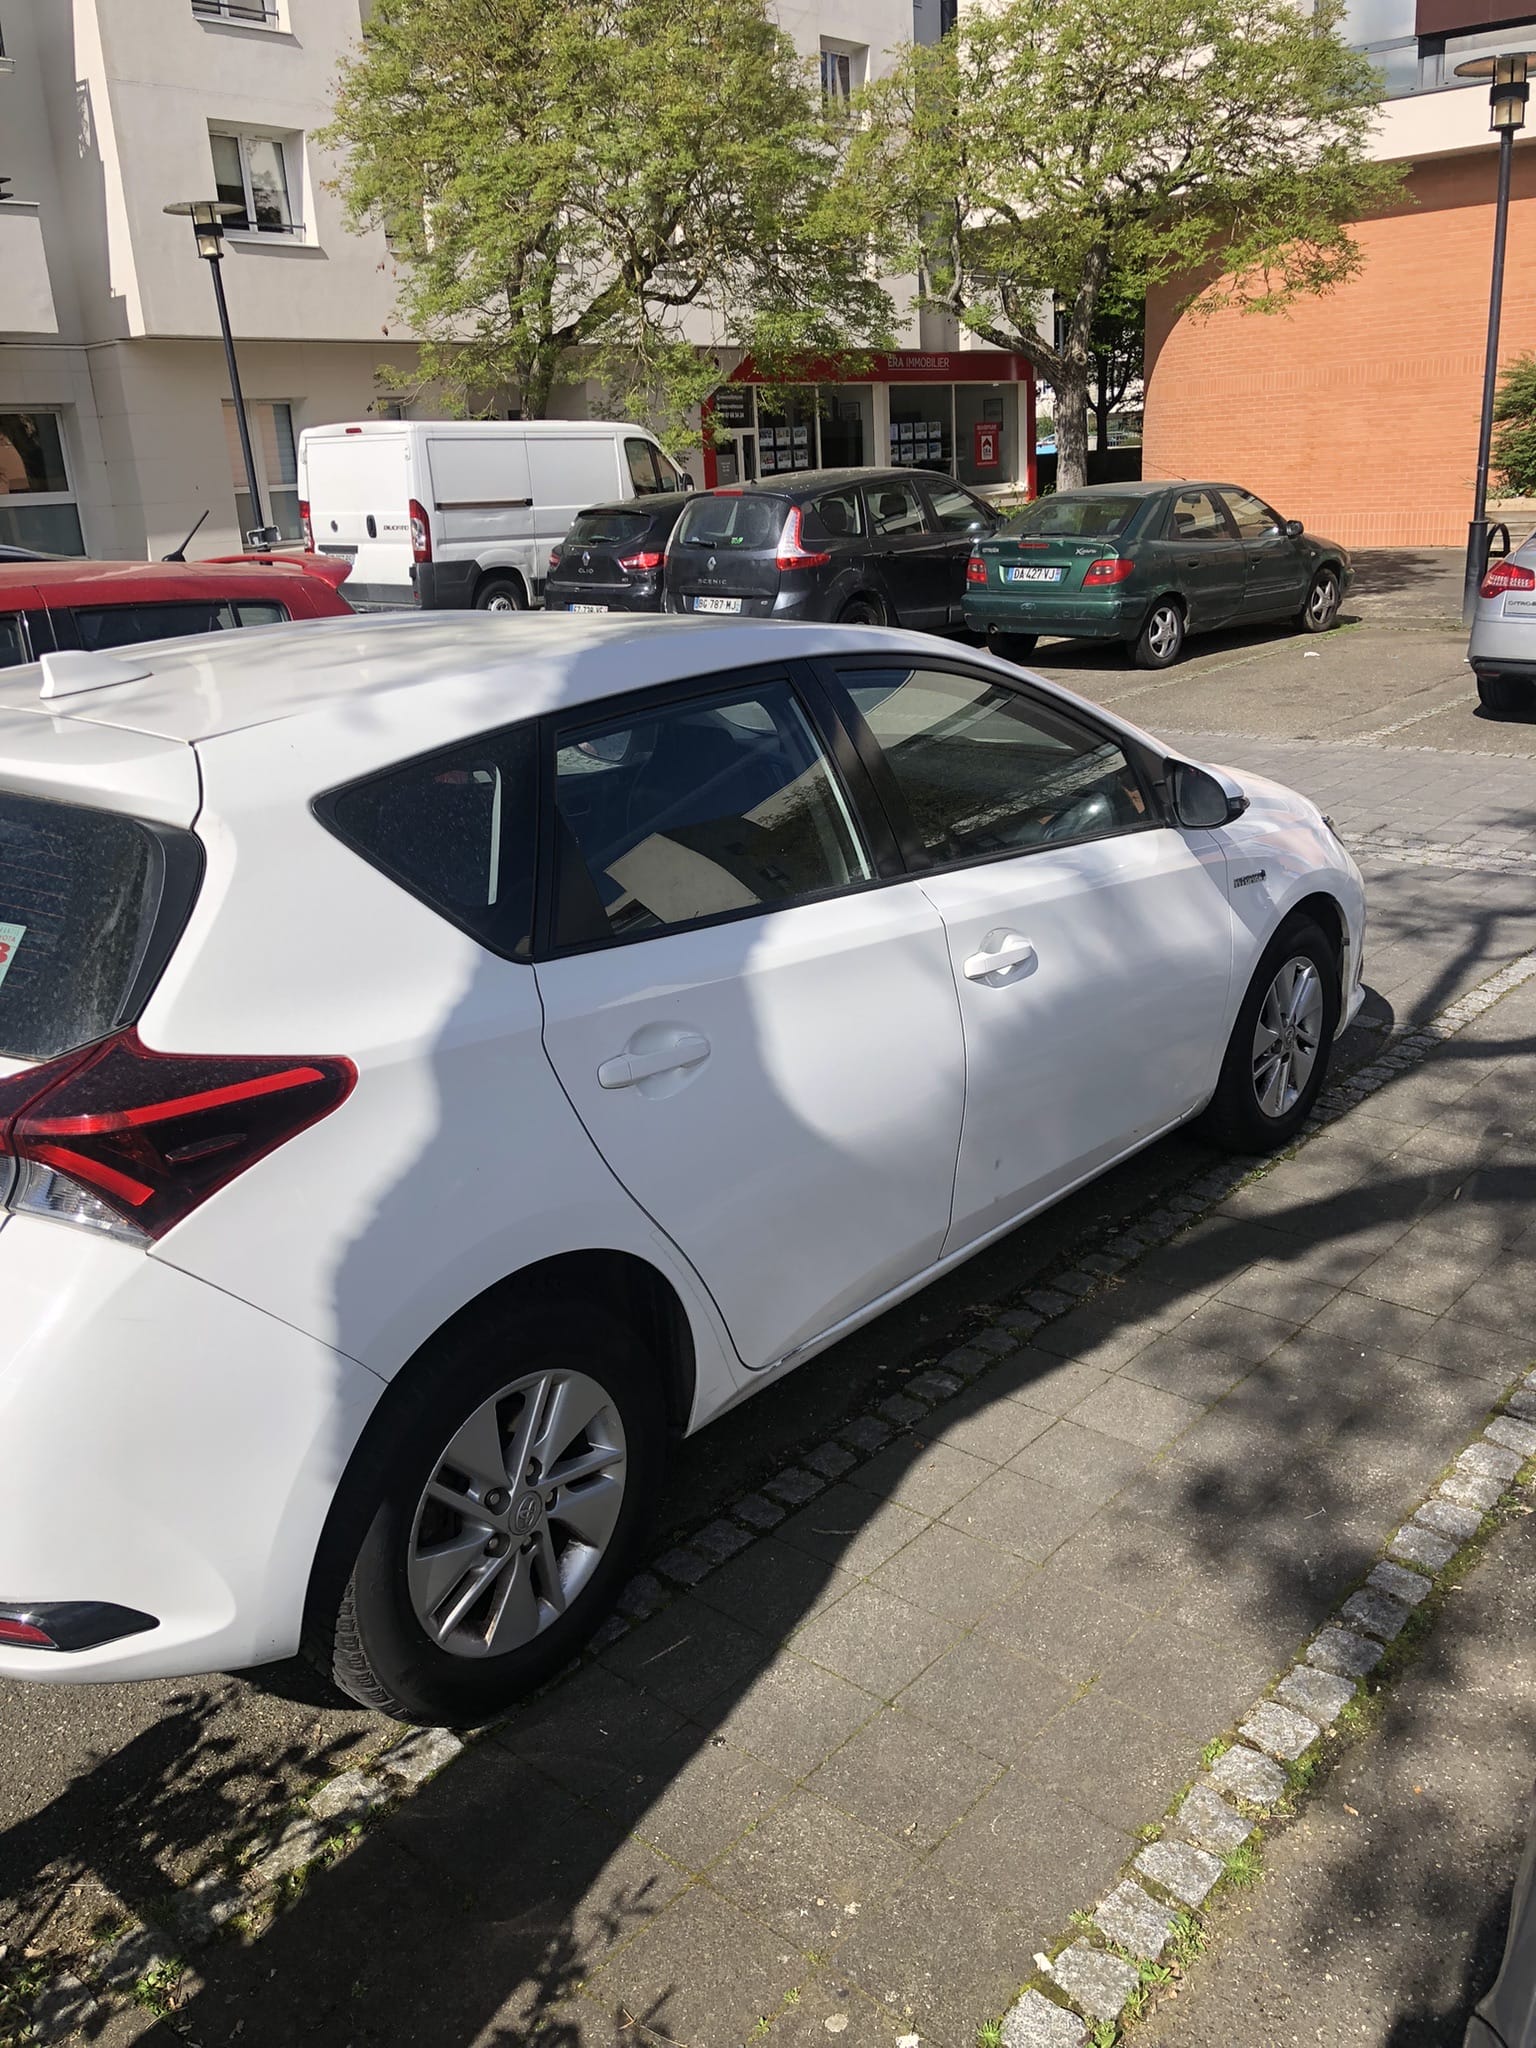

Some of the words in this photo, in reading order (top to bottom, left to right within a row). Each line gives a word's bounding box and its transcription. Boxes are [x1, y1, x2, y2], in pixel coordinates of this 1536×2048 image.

[905, 357, 950, 368] IMMOBILIER
[1013, 568, 1025, 580] DA
[1026, 567, 1042, 580] 427
[1044, 568, 1056, 580] VJ
[709, 599, 725, 610] 787
[725, 600, 736, 610] MJ
